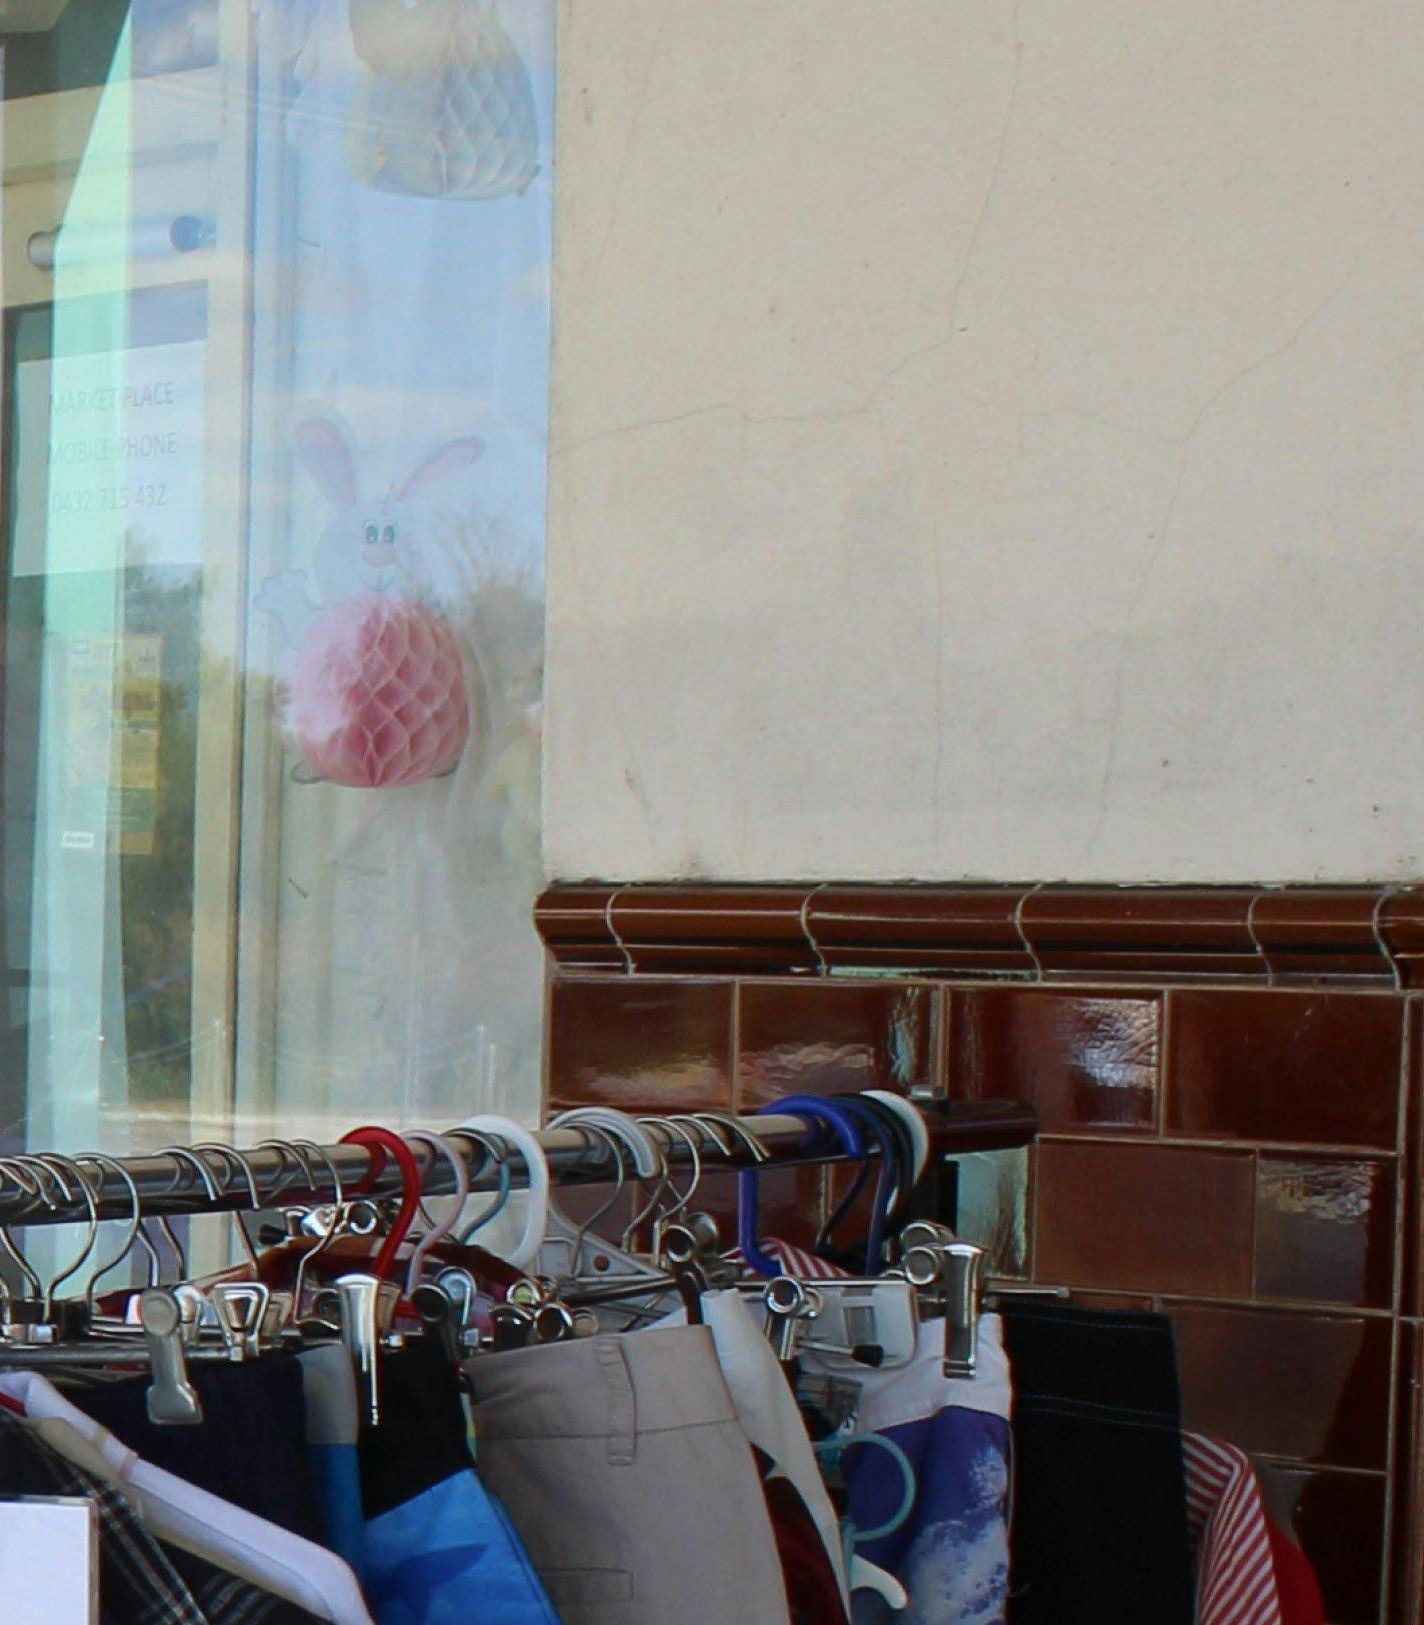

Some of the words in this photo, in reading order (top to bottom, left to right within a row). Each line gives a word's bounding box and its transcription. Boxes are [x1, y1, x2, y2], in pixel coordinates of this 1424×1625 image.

[50, 387, 118, 416] MARKET
[123, 381, 175, 408] PLACE
[48, 438, 114, 466] MOBILE
[119, 431, 179, 459] PHONE
[133, 483, 167, 507] 432
